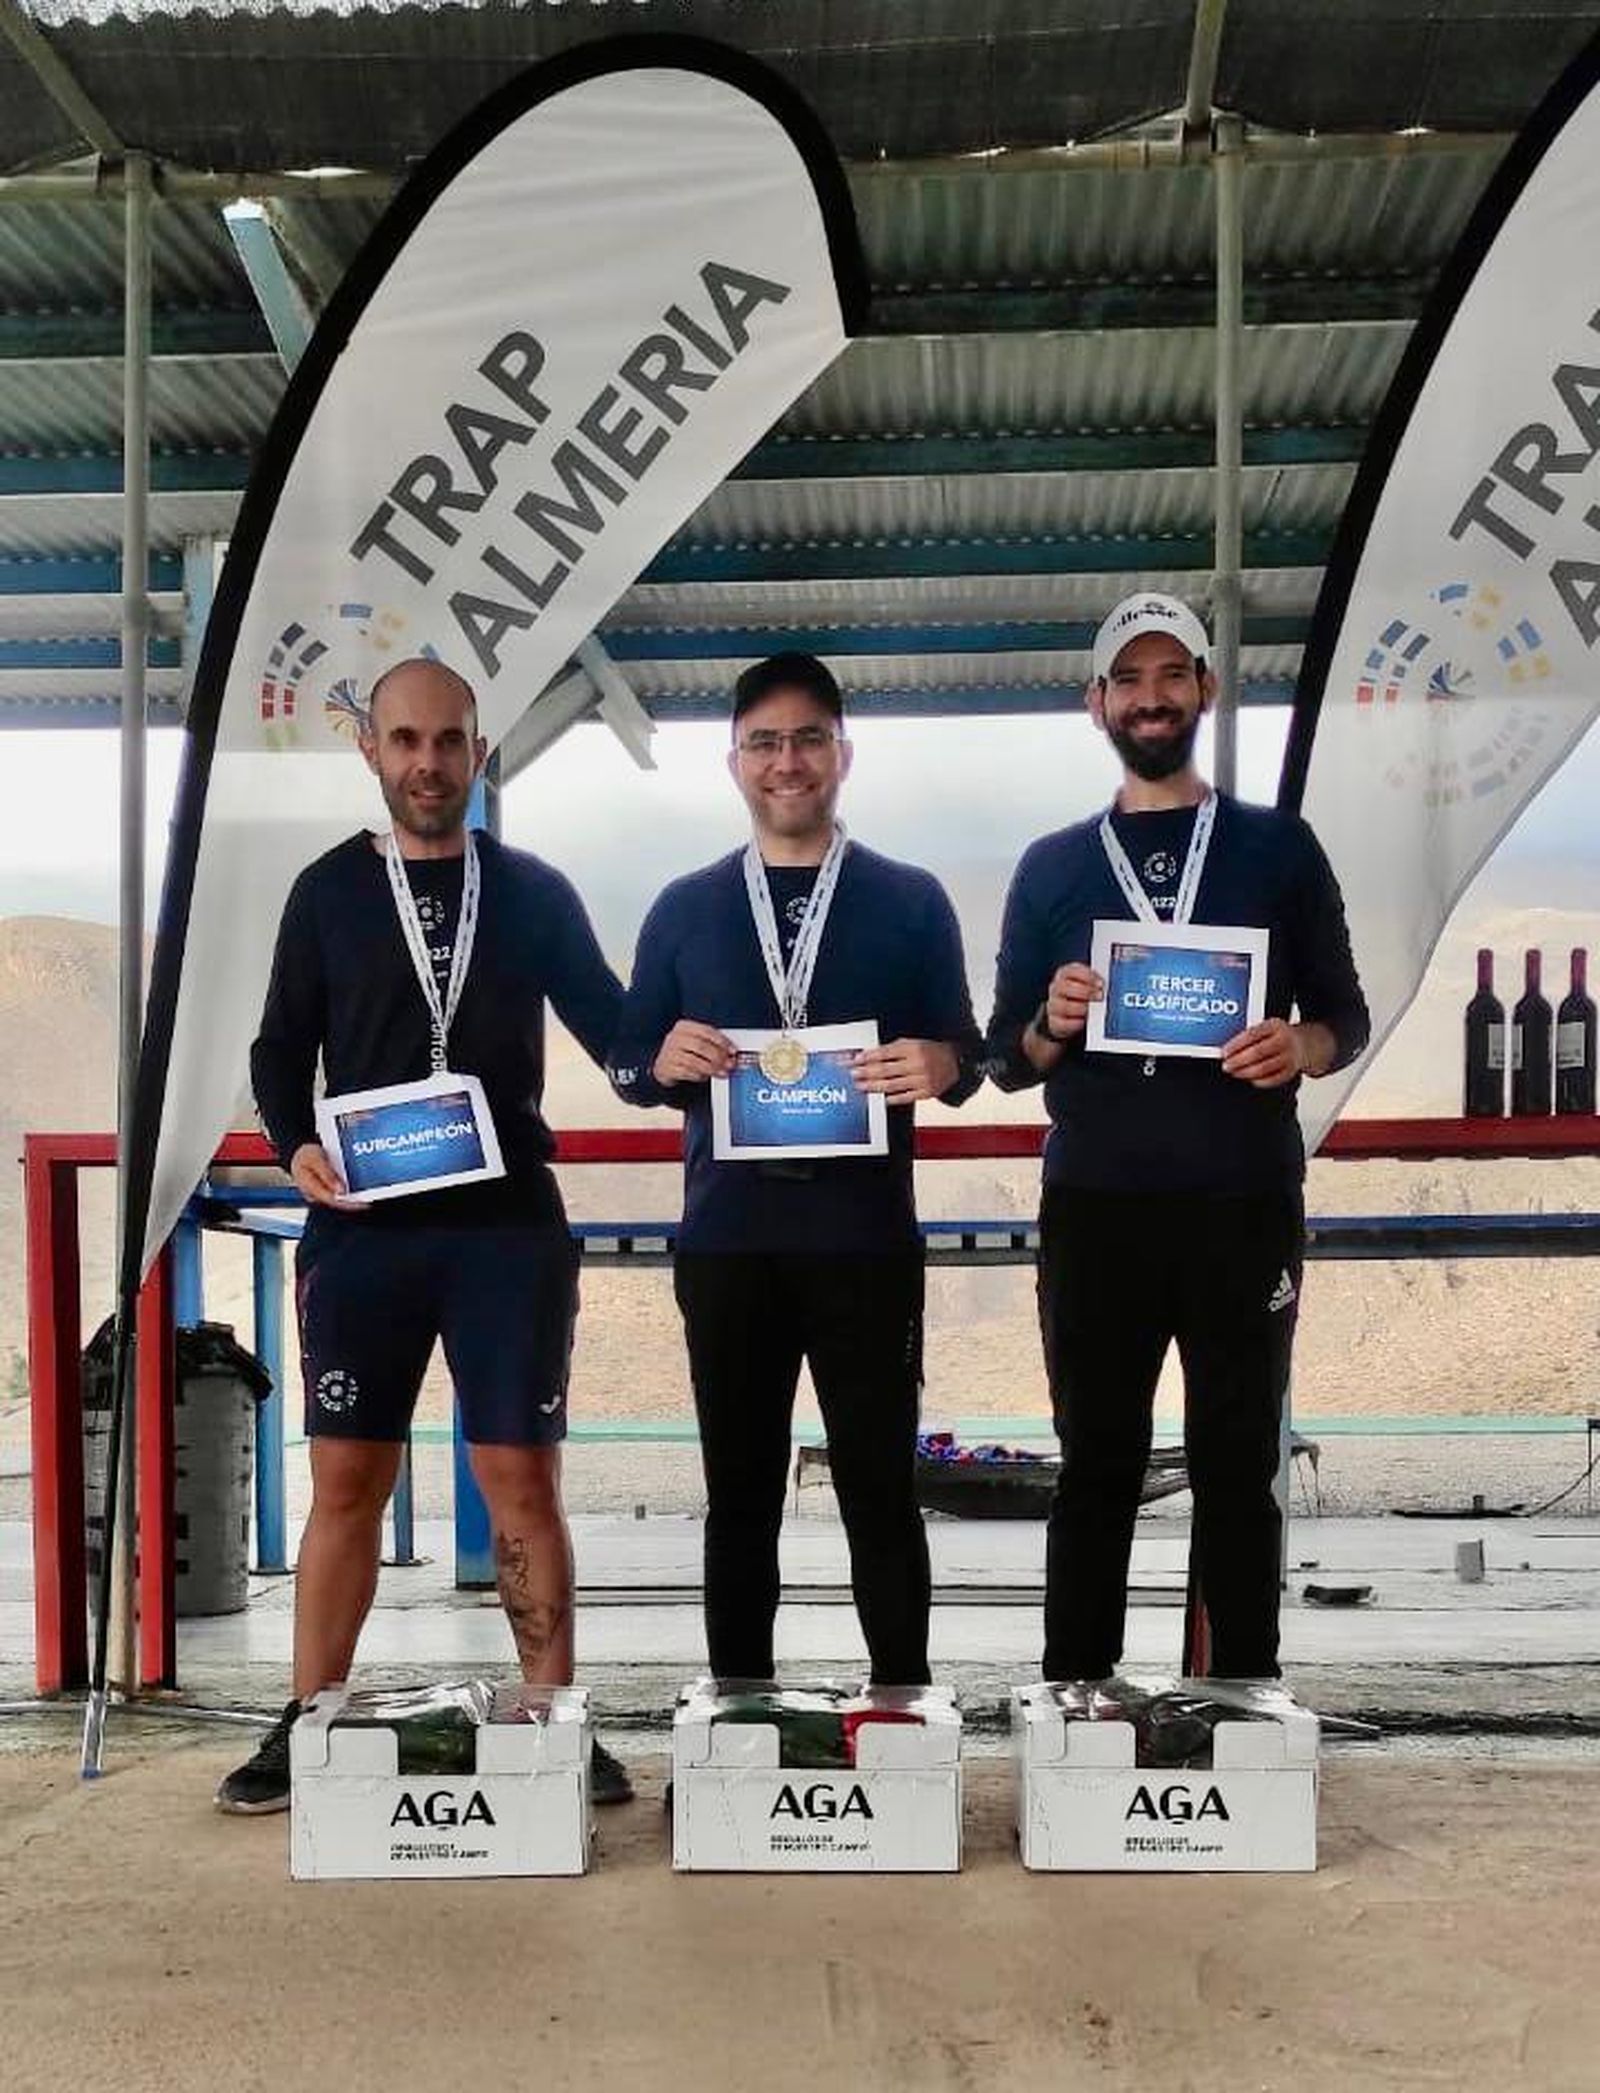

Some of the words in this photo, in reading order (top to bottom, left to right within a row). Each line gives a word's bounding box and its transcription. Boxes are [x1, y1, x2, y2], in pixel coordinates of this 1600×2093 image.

[1448, 309, 1600, 561] TRA
[349, 330, 552, 586] TRAP
[447, 260, 792, 678] ALMERIA
[1149, 974, 1216, 994] TERCER
[1123, 992, 1238, 1014] CLASIFICADO
[757, 1085, 847, 1104] CAMPEÓN
[352, 1119, 473, 1156] SUBCAMPEÓN
[390, 1790, 496, 1828] AGA
[770, 1783, 874, 1820] AGA
[1125, 1785, 1230, 1822] AGA
